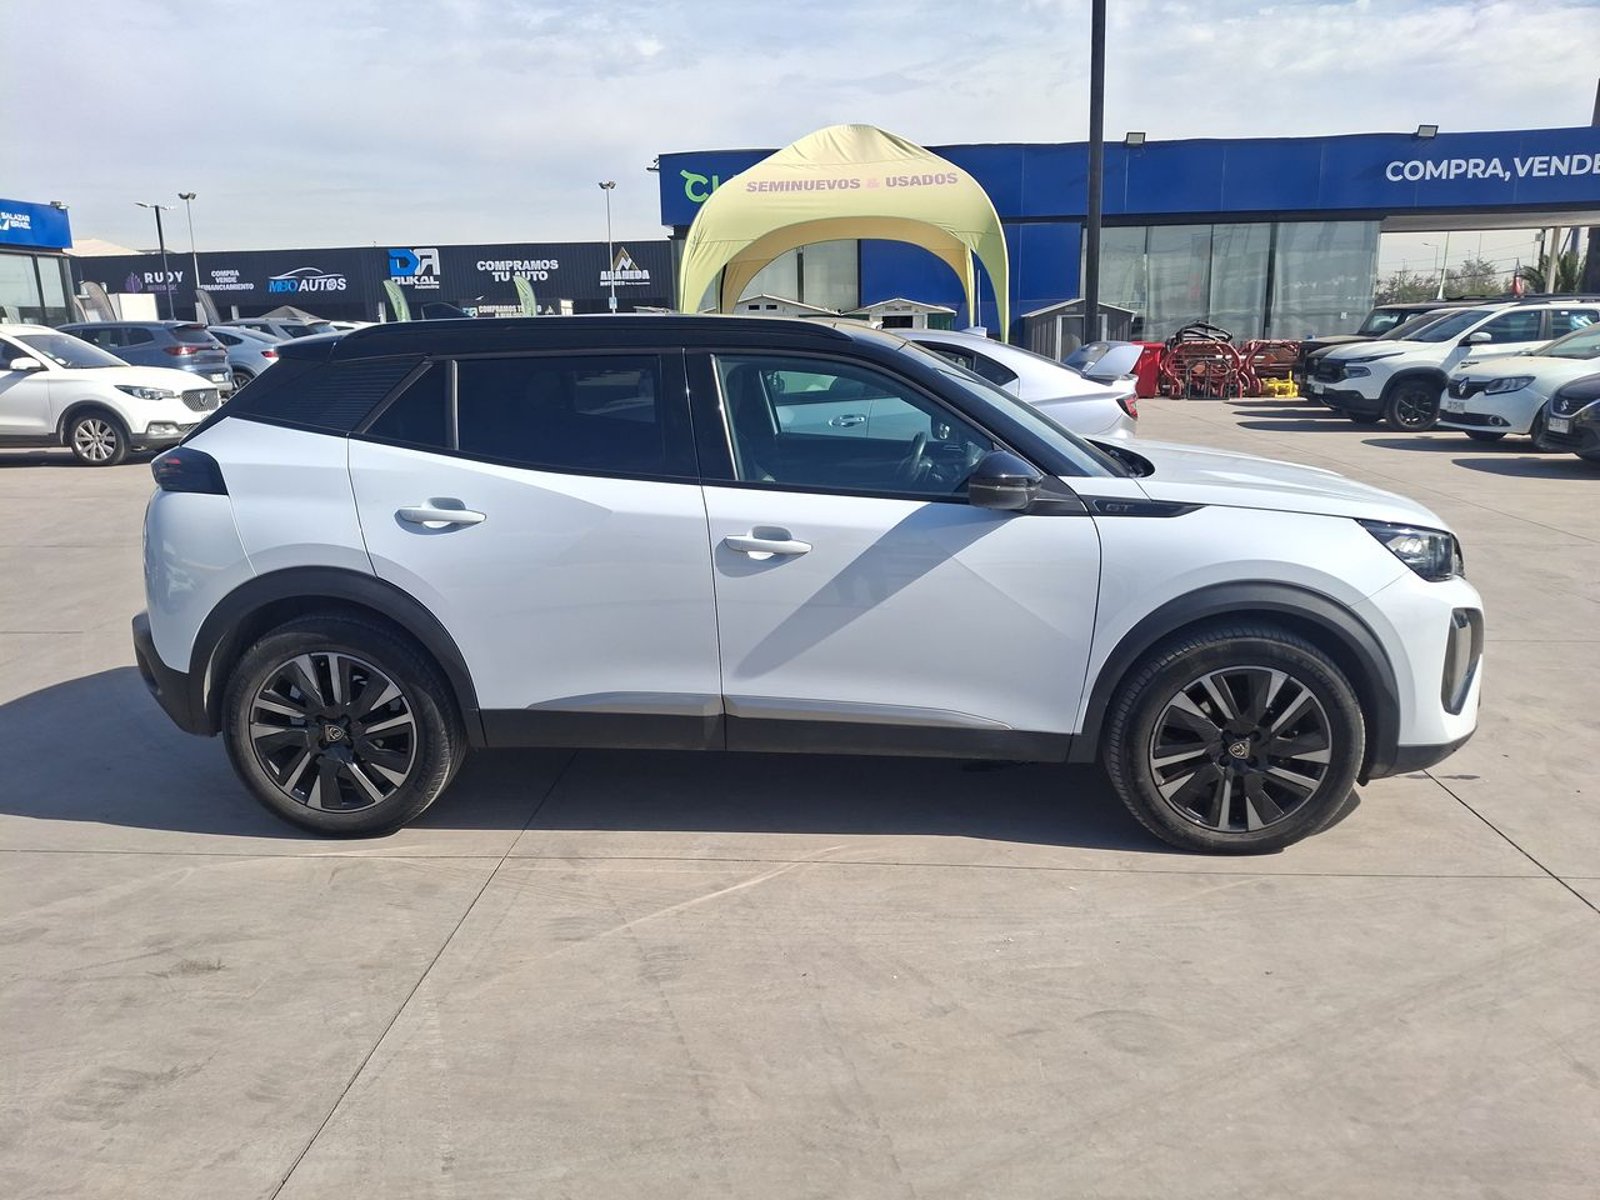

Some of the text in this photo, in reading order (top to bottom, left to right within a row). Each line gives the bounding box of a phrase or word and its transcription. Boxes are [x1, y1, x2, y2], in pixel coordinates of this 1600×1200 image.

[746, 178, 860, 193] SEMINUEVOS
[886, 172, 958, 188] USADOS
[477, 259, 559, 272] COMPRAMOS
[211, 270, 240, 278] COMPRA
[493, 271, 509, 282] TU
[299, 278, 347, 292] AUTOS
[1105, 503, 1135, 513] GT
